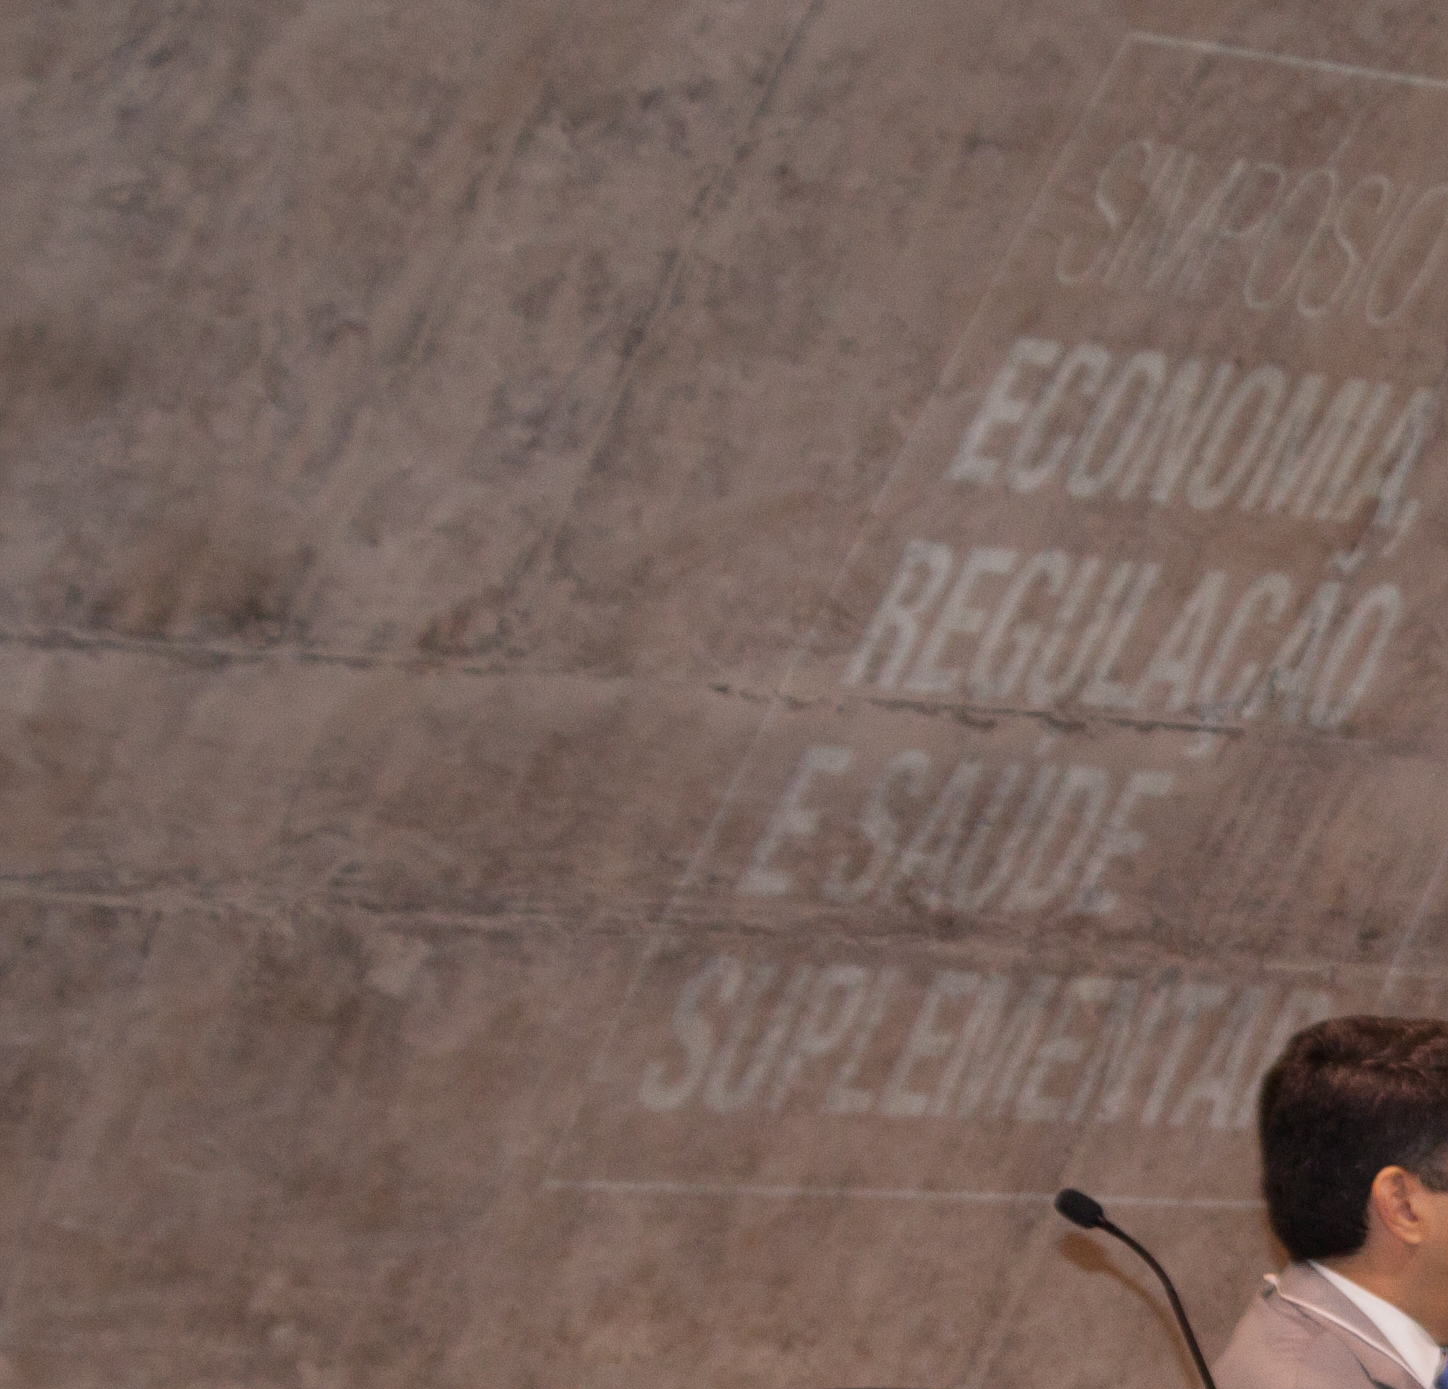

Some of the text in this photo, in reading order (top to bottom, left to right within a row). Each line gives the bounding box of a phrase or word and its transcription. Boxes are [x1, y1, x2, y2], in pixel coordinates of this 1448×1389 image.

[943, 336, 1440, 560] ECONOMIA,
[842, 536, 1404, 762] REGULAÇÃO
[736, 728, 1176, 915] E SAÚDE
